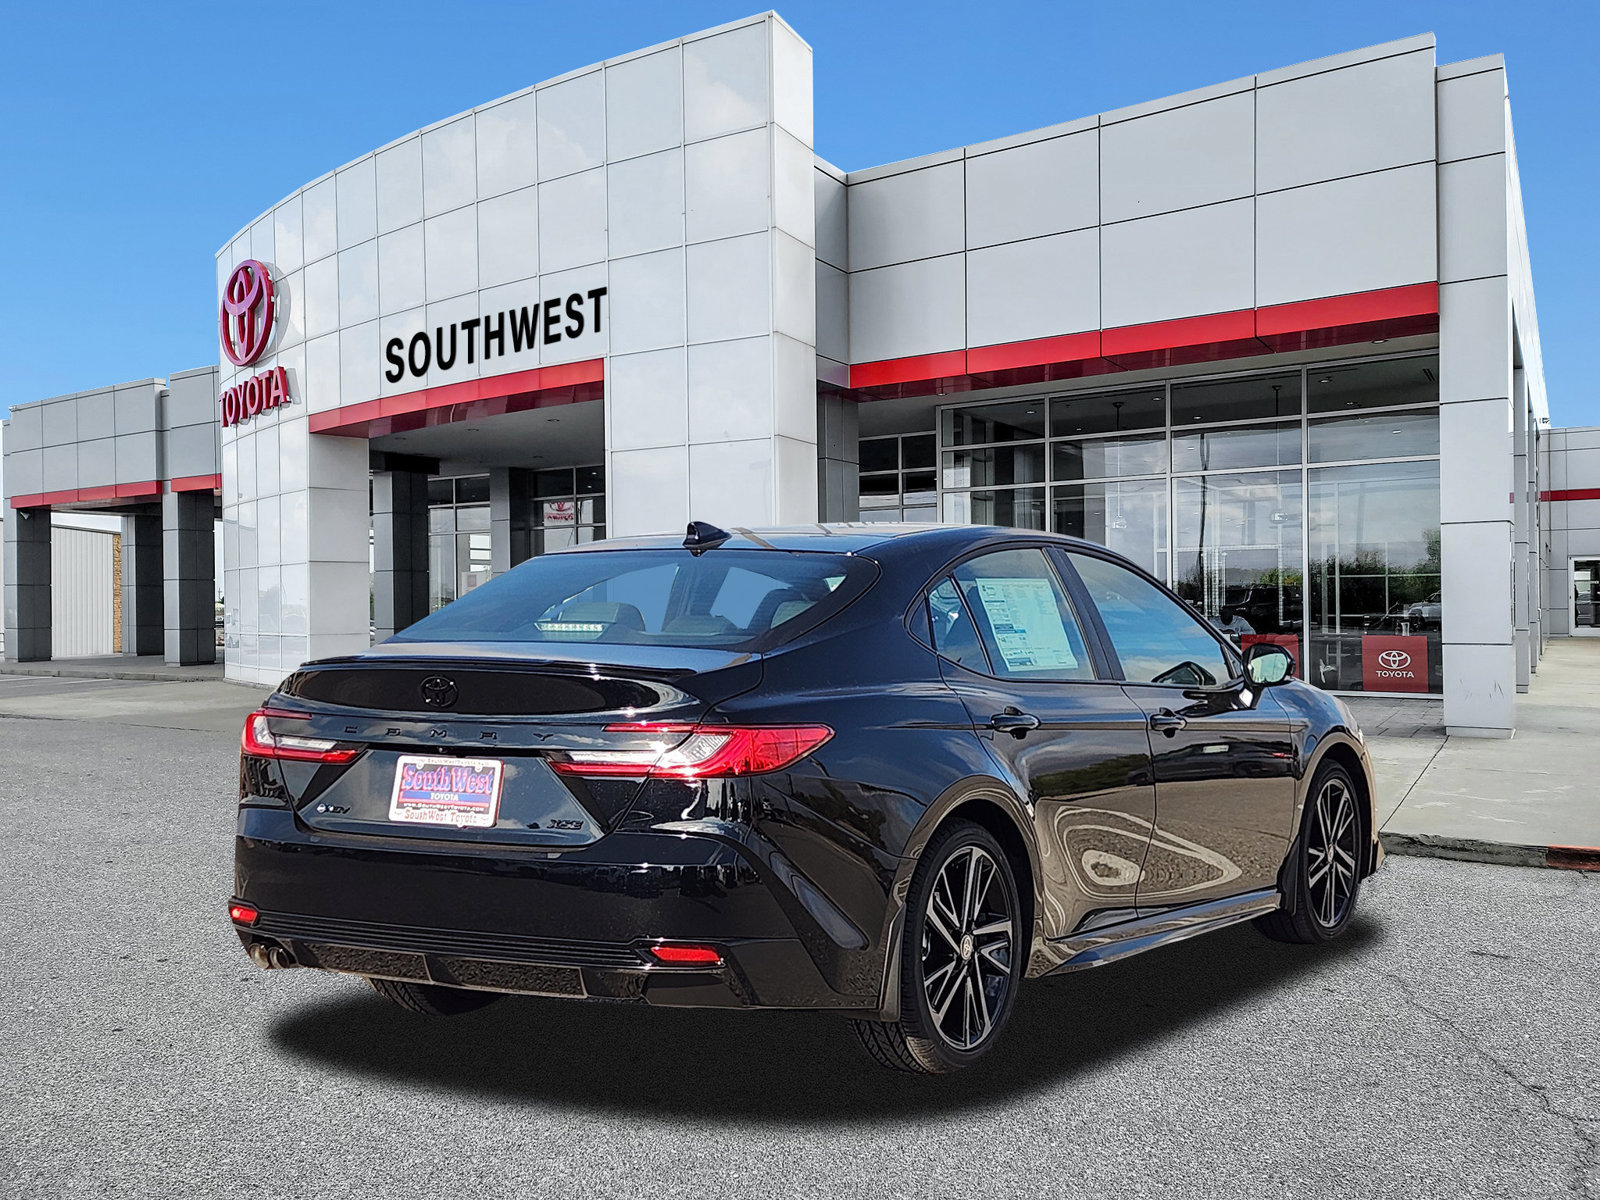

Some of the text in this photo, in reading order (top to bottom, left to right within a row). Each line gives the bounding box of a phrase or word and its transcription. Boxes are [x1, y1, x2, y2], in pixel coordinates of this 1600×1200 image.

[385, 286, 608, 384] SOUTHWEST
[218, 366, 289, 428] TOYOTA
[1375, 670, 1415, 679] TOYOTA
[344, 726, 554, 741] CAMRY
[430, 792, 459, 801] TOYOTA
